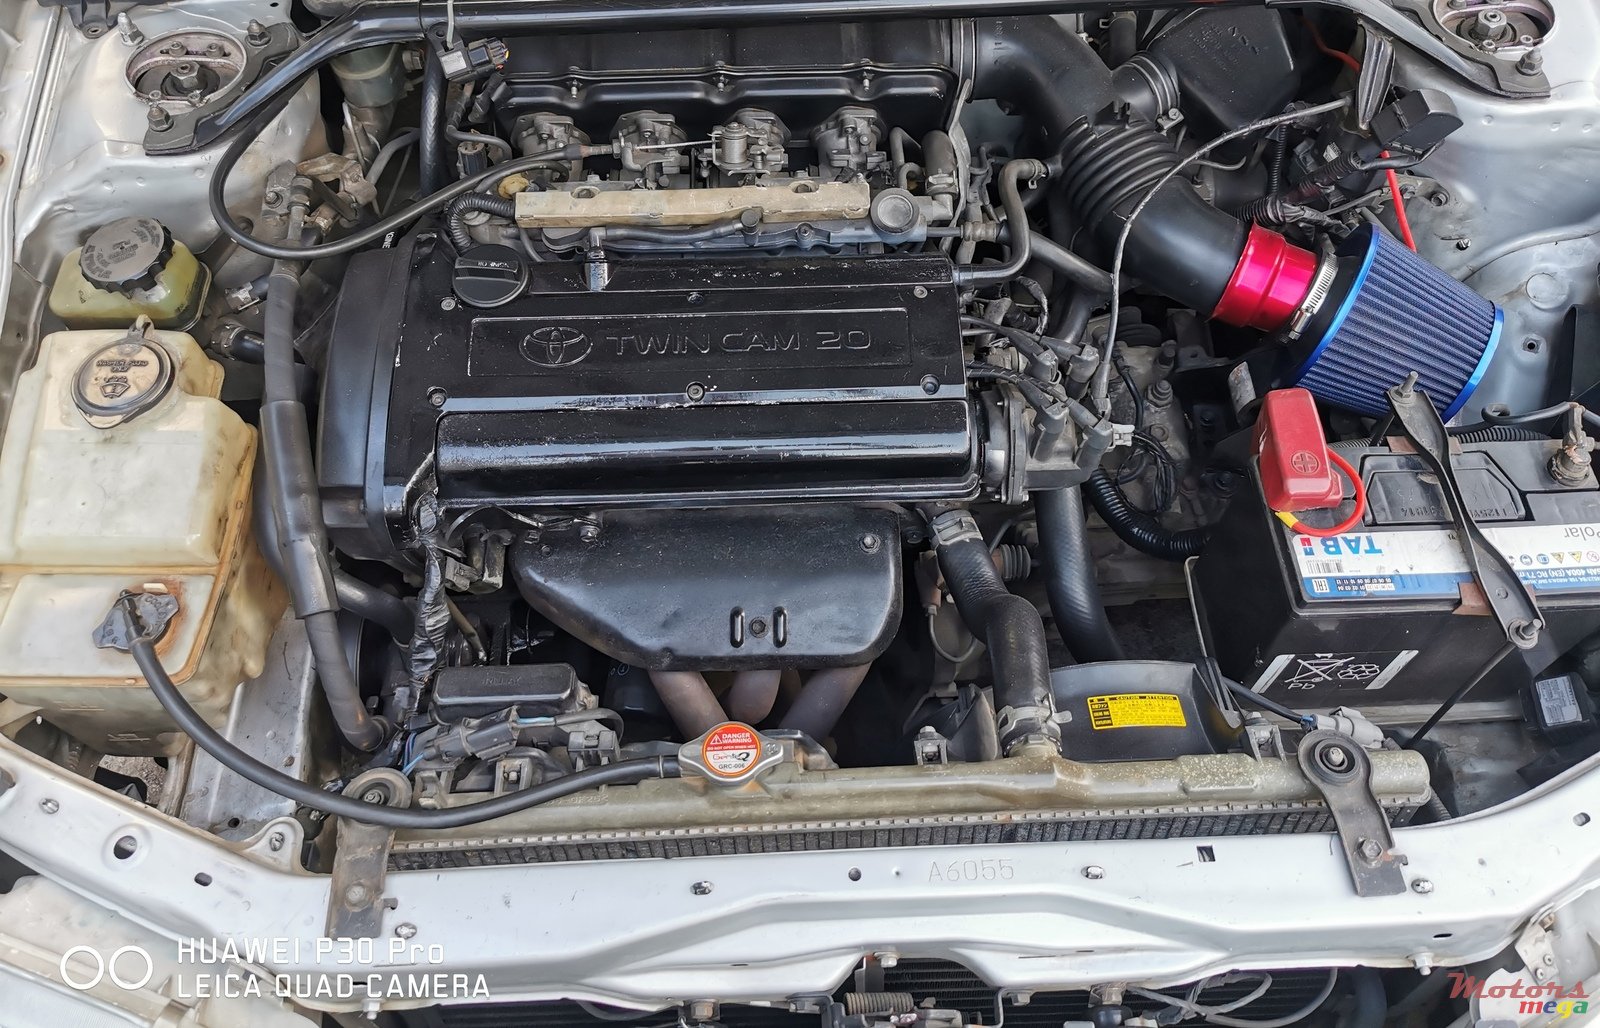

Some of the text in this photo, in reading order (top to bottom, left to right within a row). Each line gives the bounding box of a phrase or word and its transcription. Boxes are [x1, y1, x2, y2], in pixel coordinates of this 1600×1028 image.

[605, 330, 872, 355] TWIN CAM 20
[1564, 526, 1600, 541] olar
[1320, 535, 1383, 556] TAB
[1287, 682, 1316, 690] Pb
[928, 858, 1014, 882] A6055
